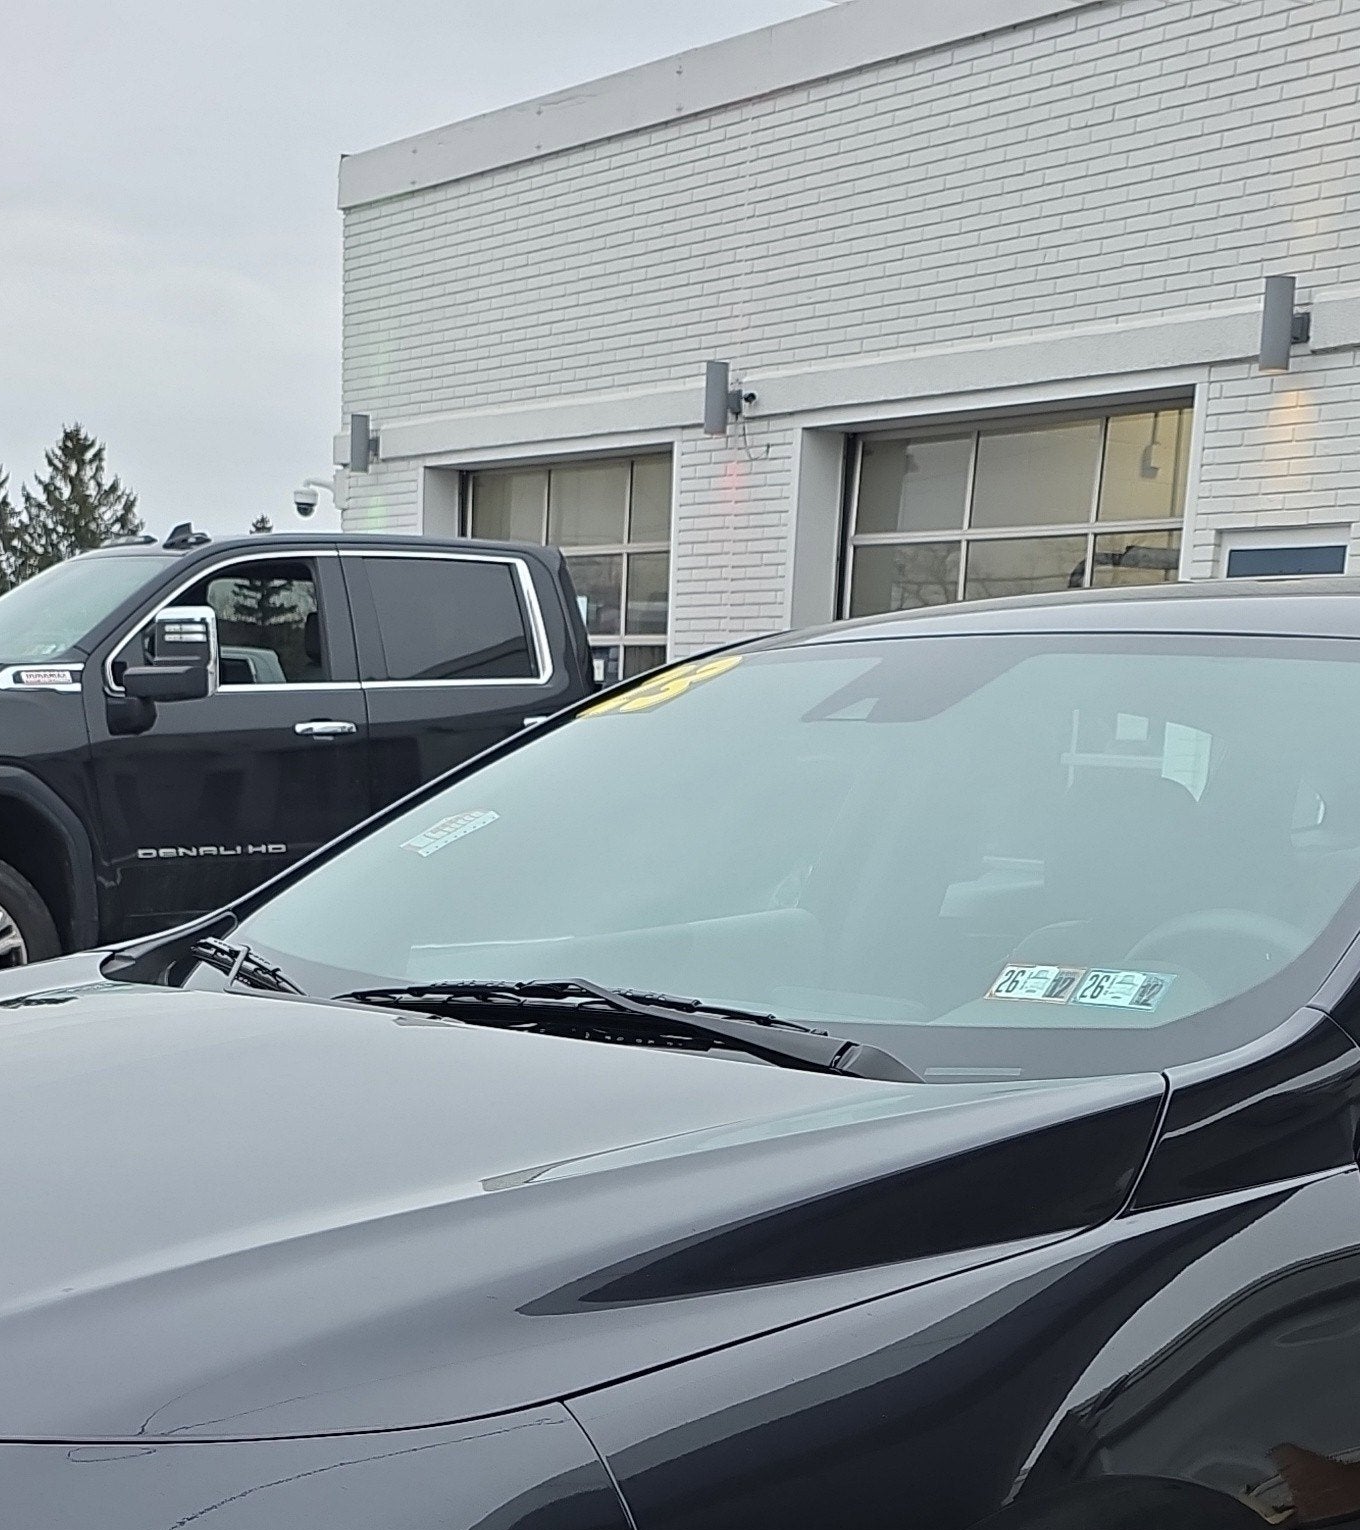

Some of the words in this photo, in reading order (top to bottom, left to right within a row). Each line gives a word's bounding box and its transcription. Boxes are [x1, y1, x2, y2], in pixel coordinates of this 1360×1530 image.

[136, 845, 242, 859] DENALI
[247, 843, 287, 855] HD
[995, 969, 1026, 993] 26
[1079, 973, 1111, 999] 26
